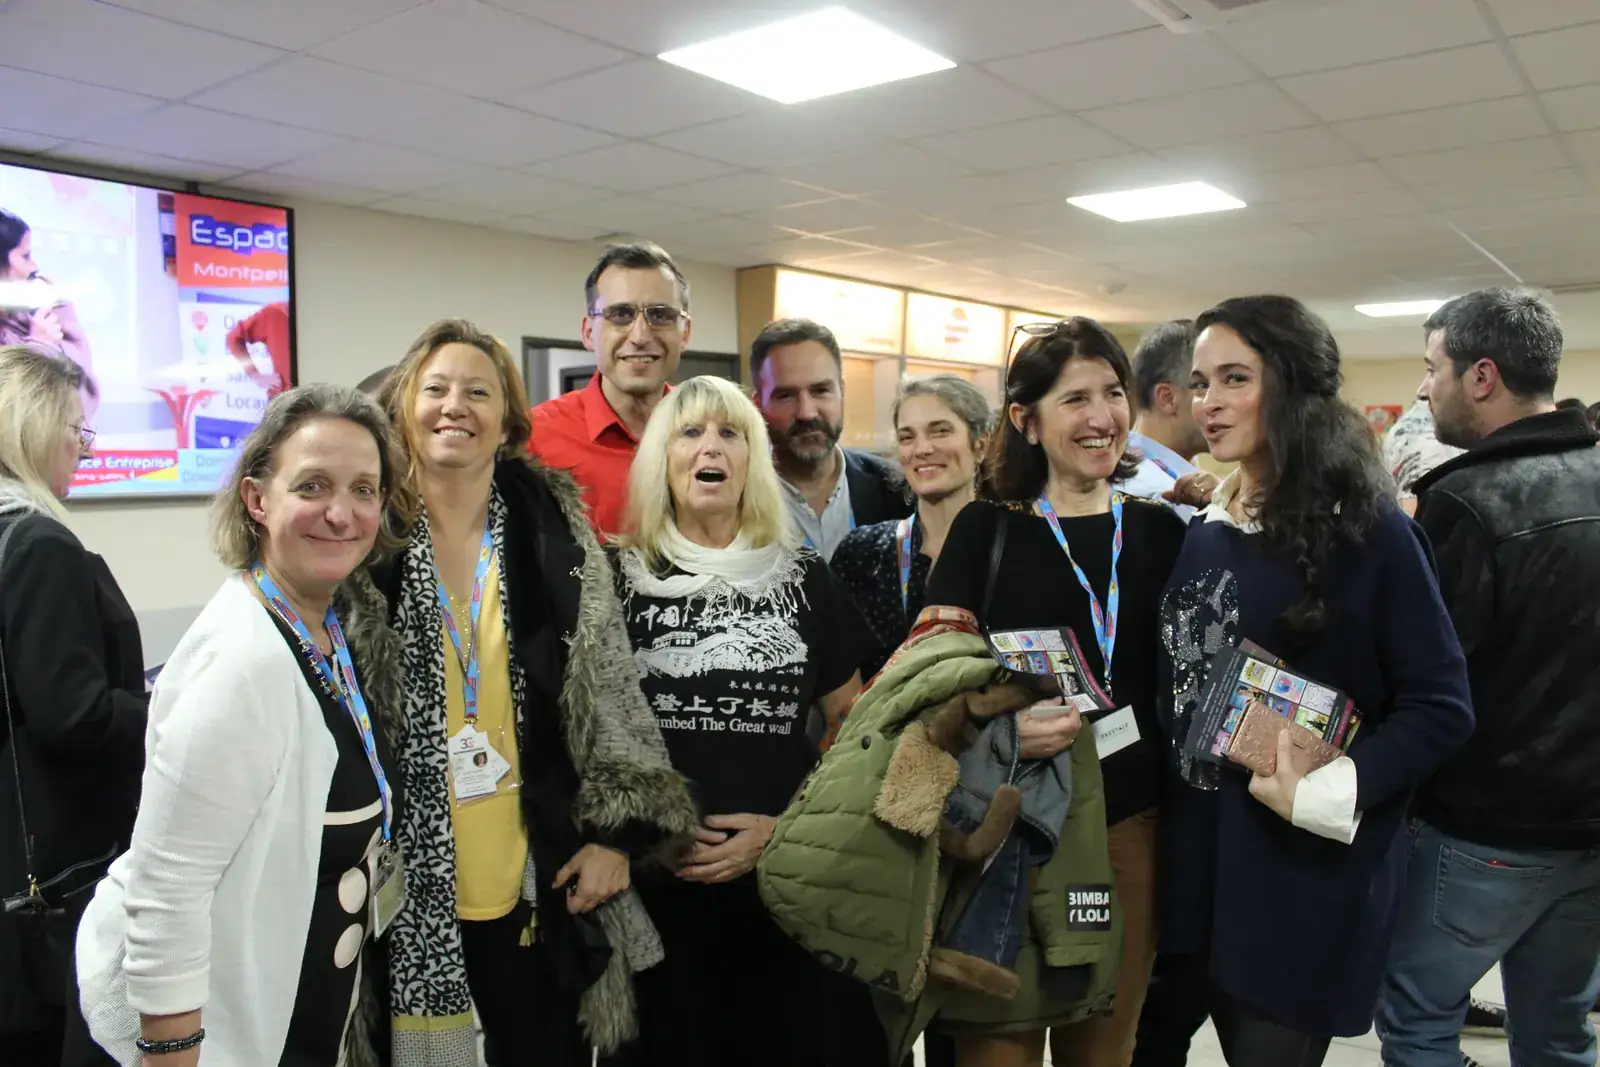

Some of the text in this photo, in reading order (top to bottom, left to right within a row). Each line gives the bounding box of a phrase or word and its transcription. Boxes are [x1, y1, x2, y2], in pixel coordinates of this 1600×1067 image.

[191, 219, 288, 252] Espac
[193, 262, 288, 283] Montpell
[106, 456, 174, 470] Entreprise
[699, 716, 726, 731] The
[729, 717, 766, 734] Great
[768, 721, 792, 735] wall
[1077, 909, 1110, 922] LOLA
